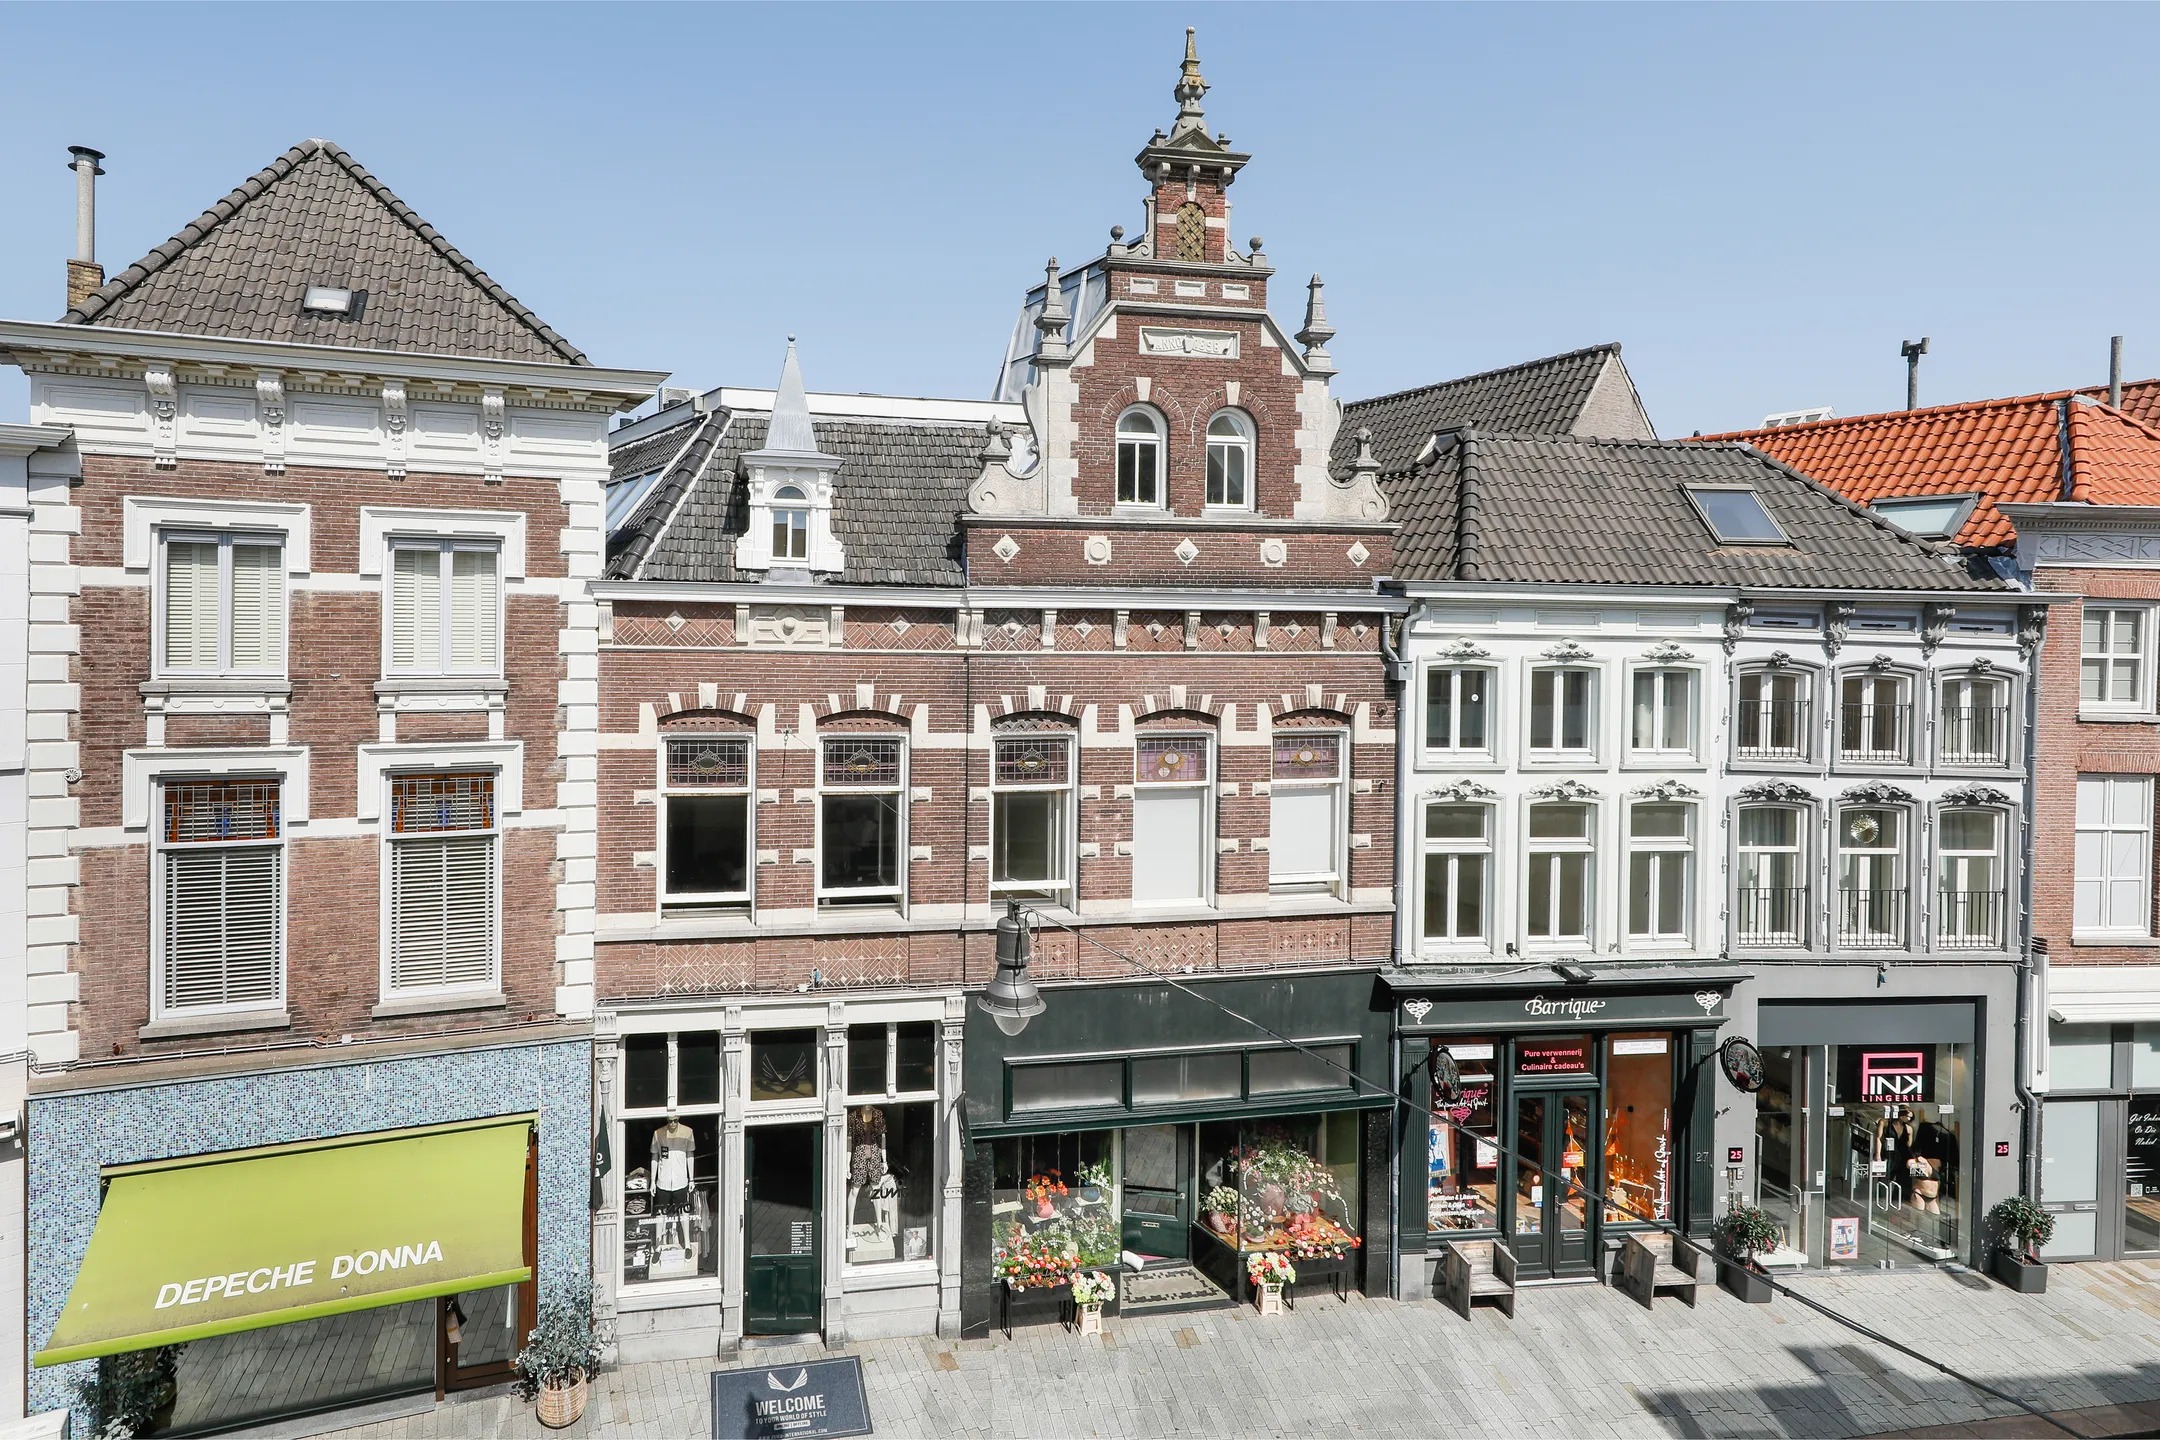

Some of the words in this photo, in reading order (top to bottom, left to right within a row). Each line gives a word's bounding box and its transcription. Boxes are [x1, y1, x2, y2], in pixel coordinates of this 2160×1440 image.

[1156, 337, 1183, 350] ANNO
[1525, 995, 1606, 1020] Barrique
[1541, 1048, 1583, 1057] verwennerij
[1550, 1056, 1556, 1064] &
[1521, 1063, 1553, 1071] Culinaire
[1553, 1062, 1585, 1070] cadeau's
[1861, 1094, 1923, 1103] LINGERIE
[2128, 1113, 2143, 1125] Get
[2144, 1125, 2157, 1134] Die
[2134, 1137, 2158, 1146] Naked
[1997, 1144, 2009, 1154] 25
[1696, 1151, 1709, 1162] 27
[1730, 1150, 1742, 1160] 25
[154, 1260, 317, 1310] DEPECHE
[330, 1240, 444, 1280] DONNA
[755, 1394, 826, 1417] WELCOME
[763, 1415, 780, 1424] YOUR
[780, 1413, 800, 1422] WORLD
[801, 1412, 808, 1420] OF
[809, 1410, 827, 1418] STYLE
